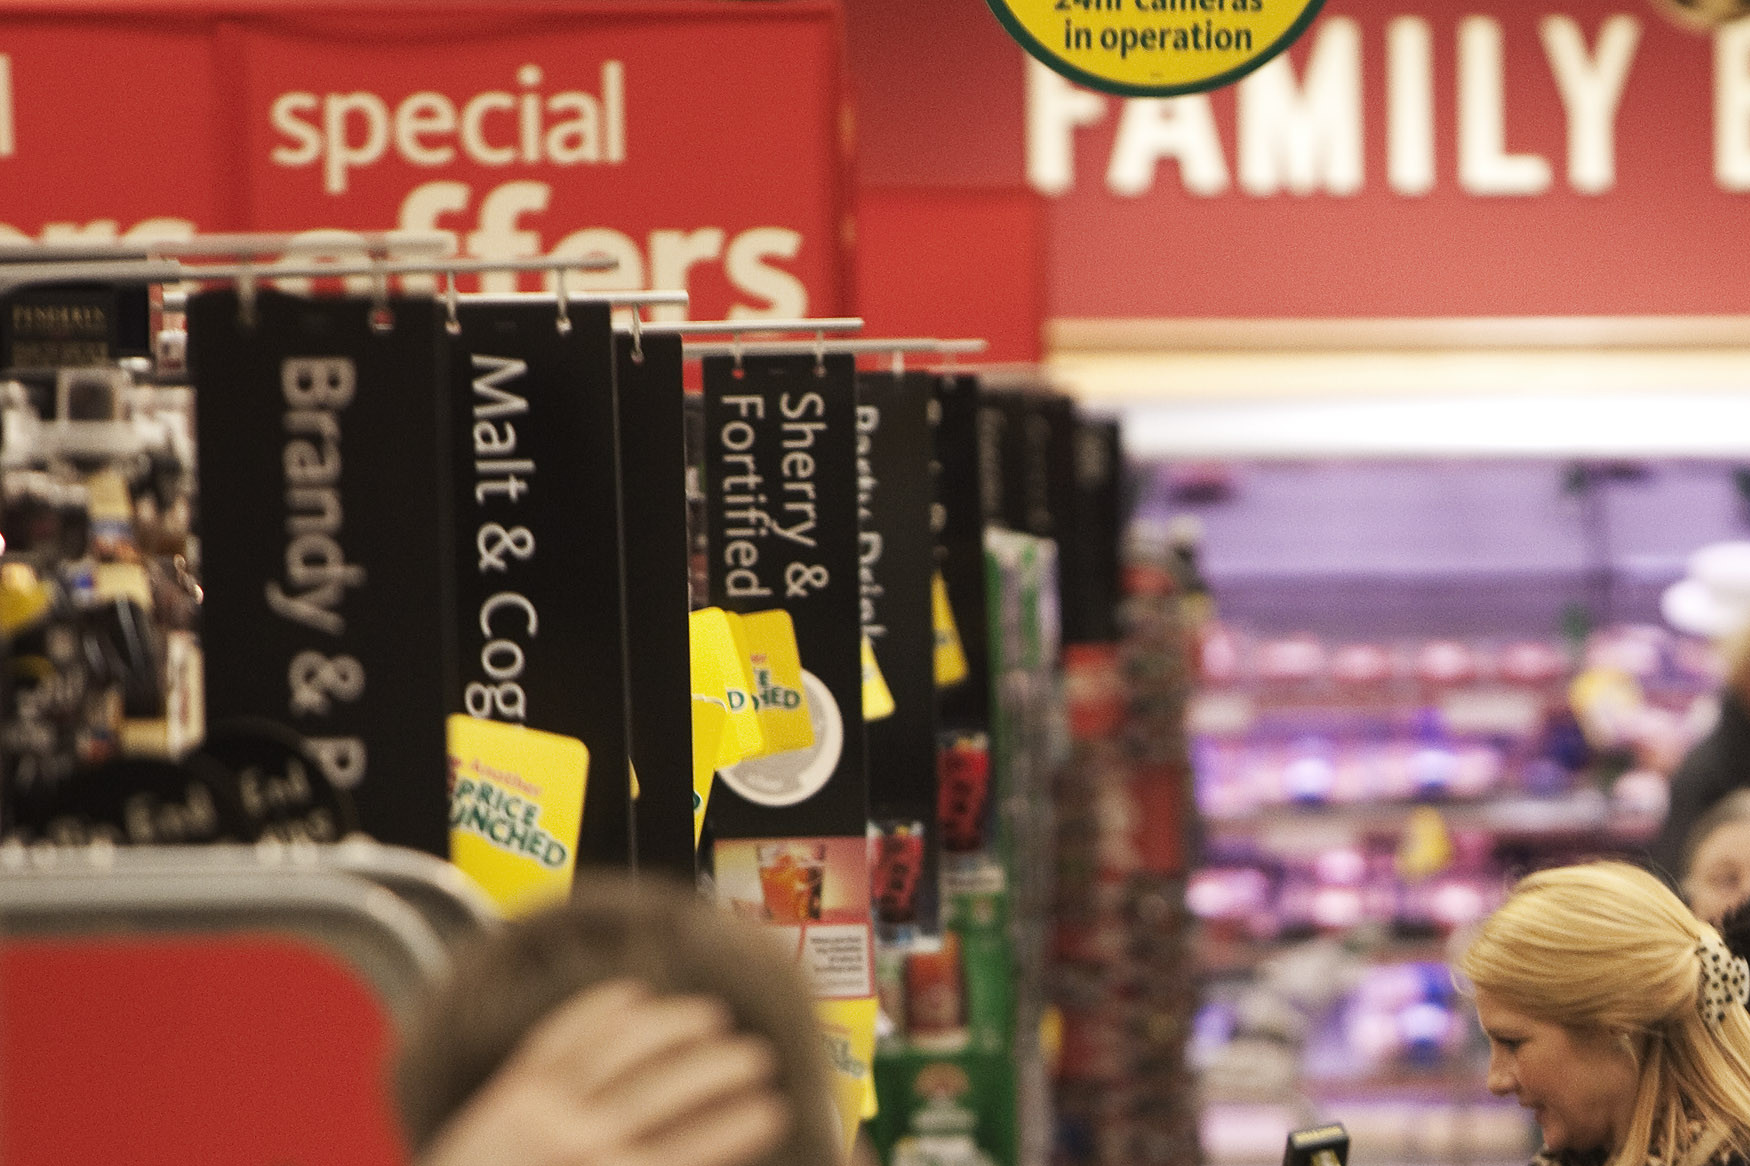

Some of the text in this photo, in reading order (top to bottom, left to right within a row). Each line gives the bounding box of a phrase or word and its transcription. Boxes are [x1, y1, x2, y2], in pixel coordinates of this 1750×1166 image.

[271, 61, 625, 193] special
[1025, 15, 1643, 195] FAMILY
[1065, 17, 1252, 59] in operation
[266, 356, 366, 636] Brandy
[464, 352, 538, 722] Malt & Cog
[721, 394, 772, 598] Fortified
[779, 392, 829, 598] Sherry &
[288, 652, 365, 716] &
[456, 780, 539, 826] PRICE
